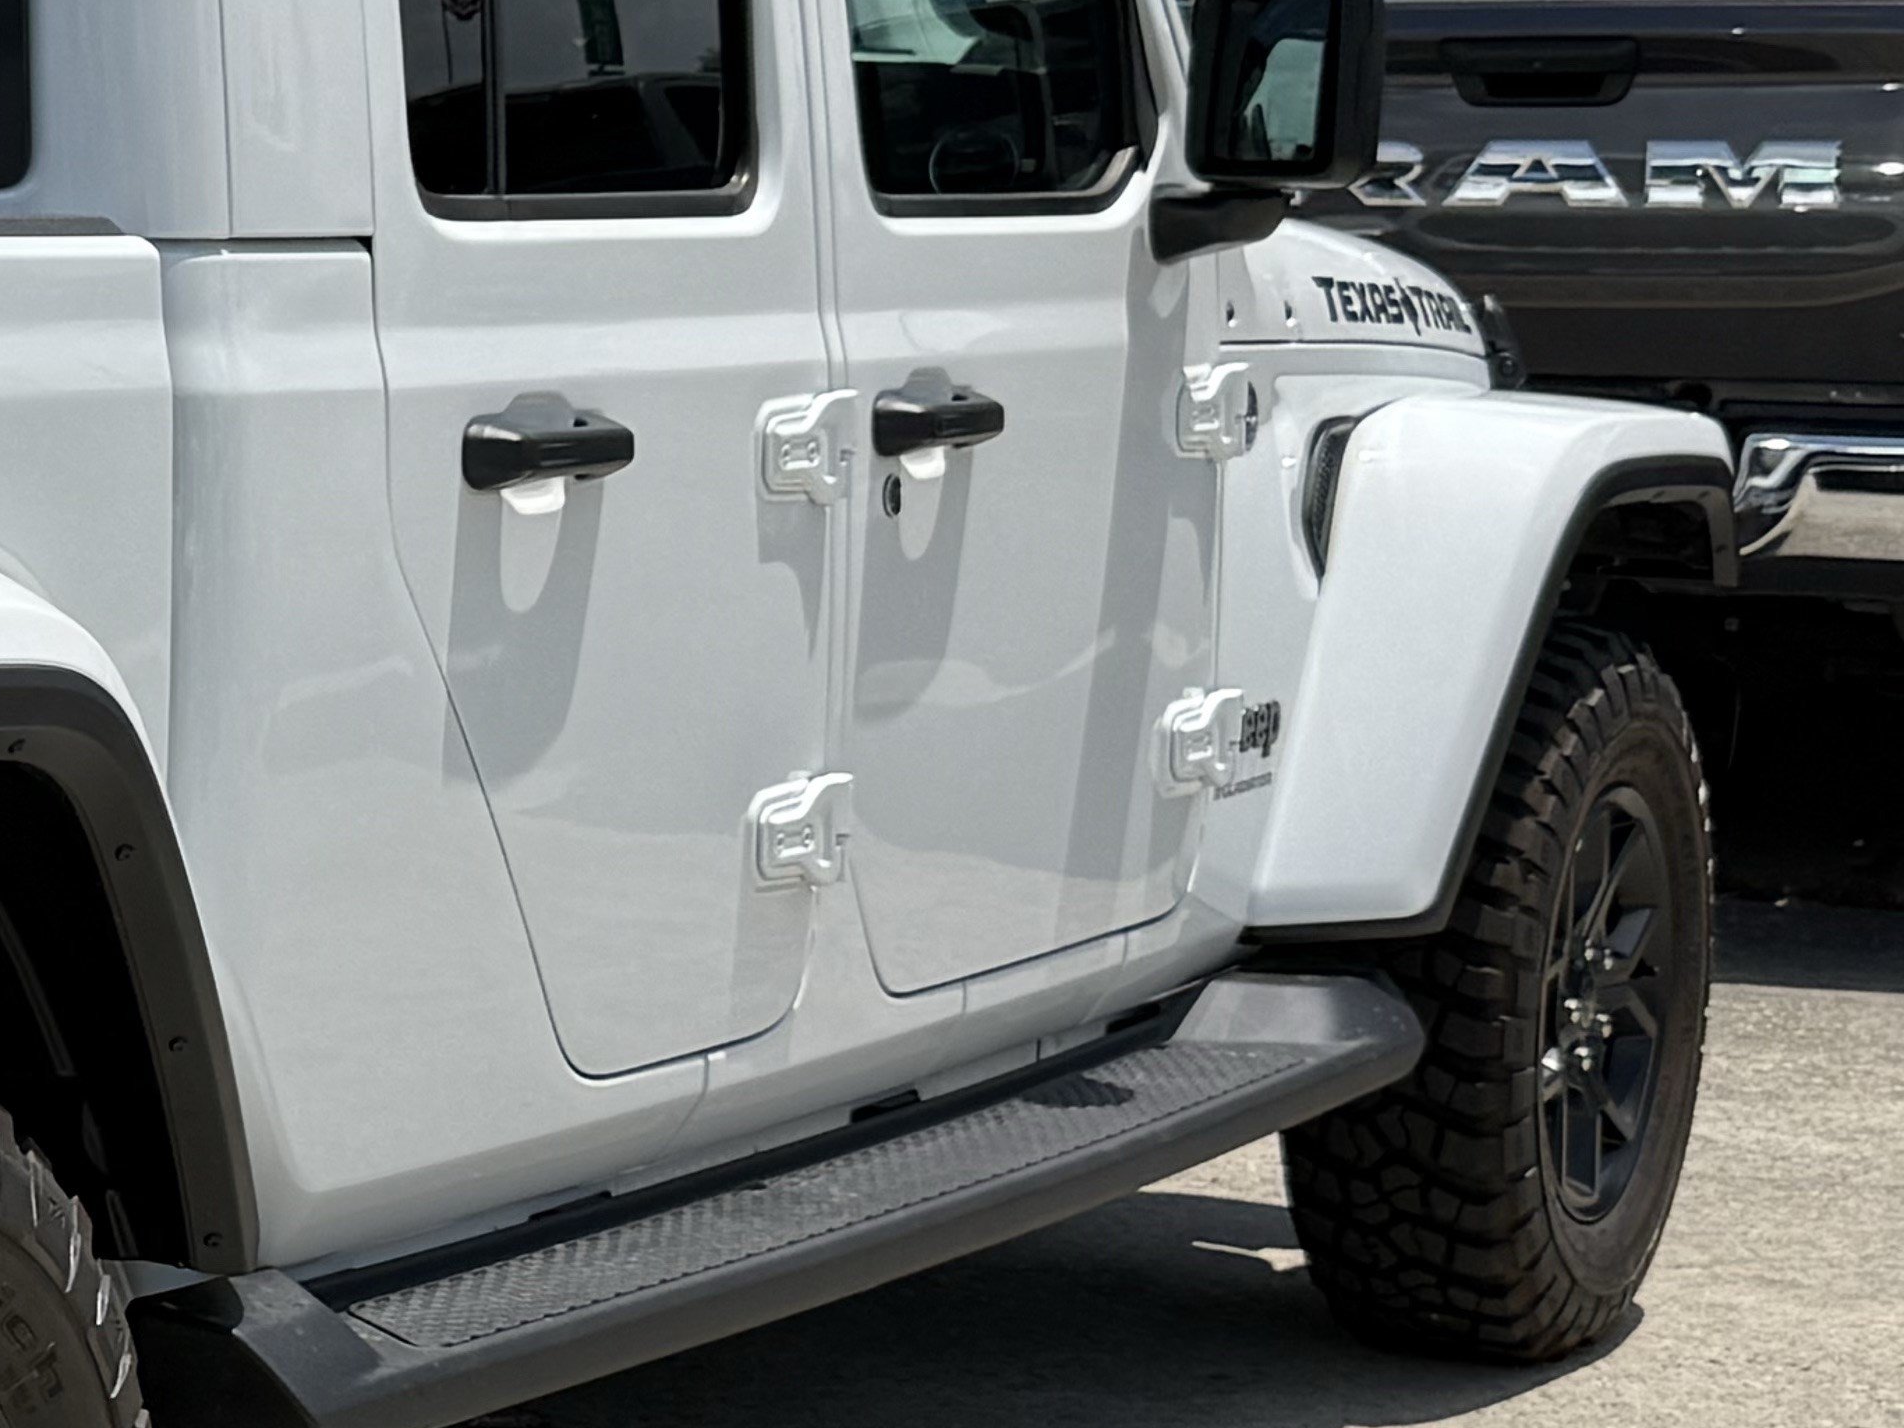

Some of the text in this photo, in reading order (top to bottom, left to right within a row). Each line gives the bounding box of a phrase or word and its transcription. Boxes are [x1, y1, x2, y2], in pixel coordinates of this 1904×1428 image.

[1312, 275, 1472, 335] TEXAS TRAIL
[1232, 700, 1281, 757] eep
